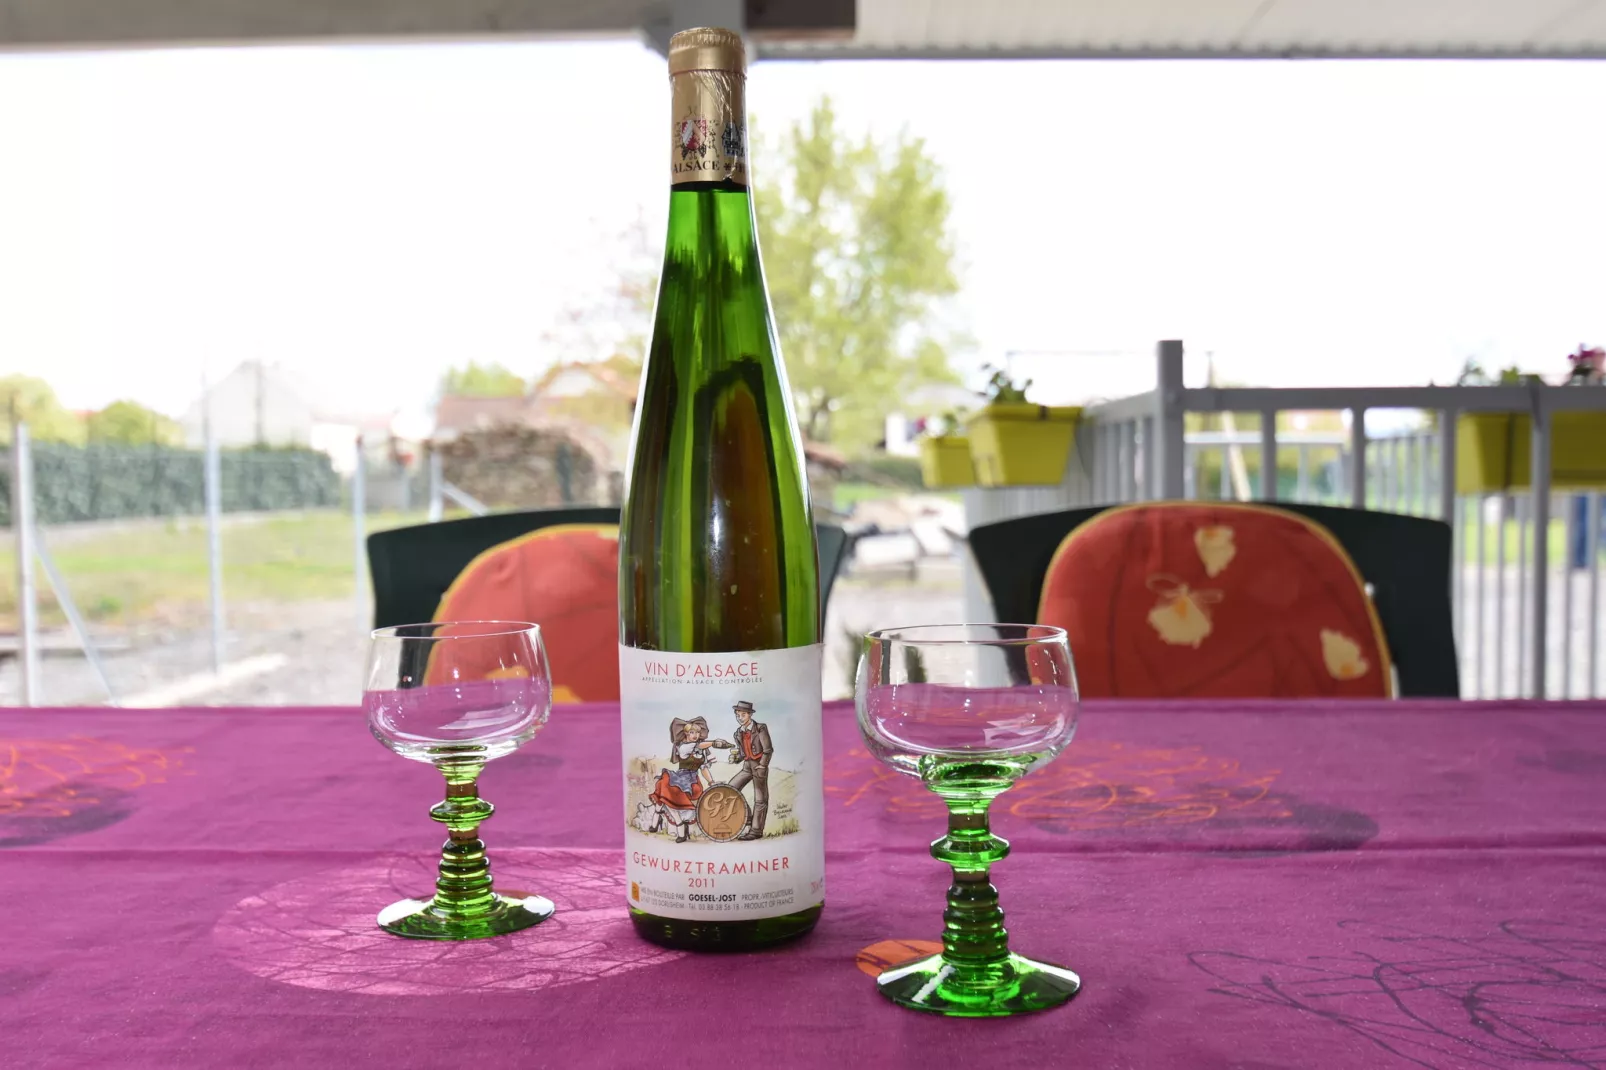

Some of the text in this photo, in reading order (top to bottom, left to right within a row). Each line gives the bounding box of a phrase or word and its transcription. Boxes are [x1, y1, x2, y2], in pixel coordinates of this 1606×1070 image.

[673, 160, 720, 173] ALSACE
[644, 661, 758, 677] VIN D'ALSACE
[641, 676, 682, 684] APPELLATION
[633, 851, 789, 875] GEWURZTRAMINER
[688, 878, 715, 888] 2011
[688, 893, 737, 902] GOESEL-JOST
[743, 901, 767, 910] PRODUCT
[768, 900, 776, 908] OF
[776, 896, 794, 906] FRANCE
